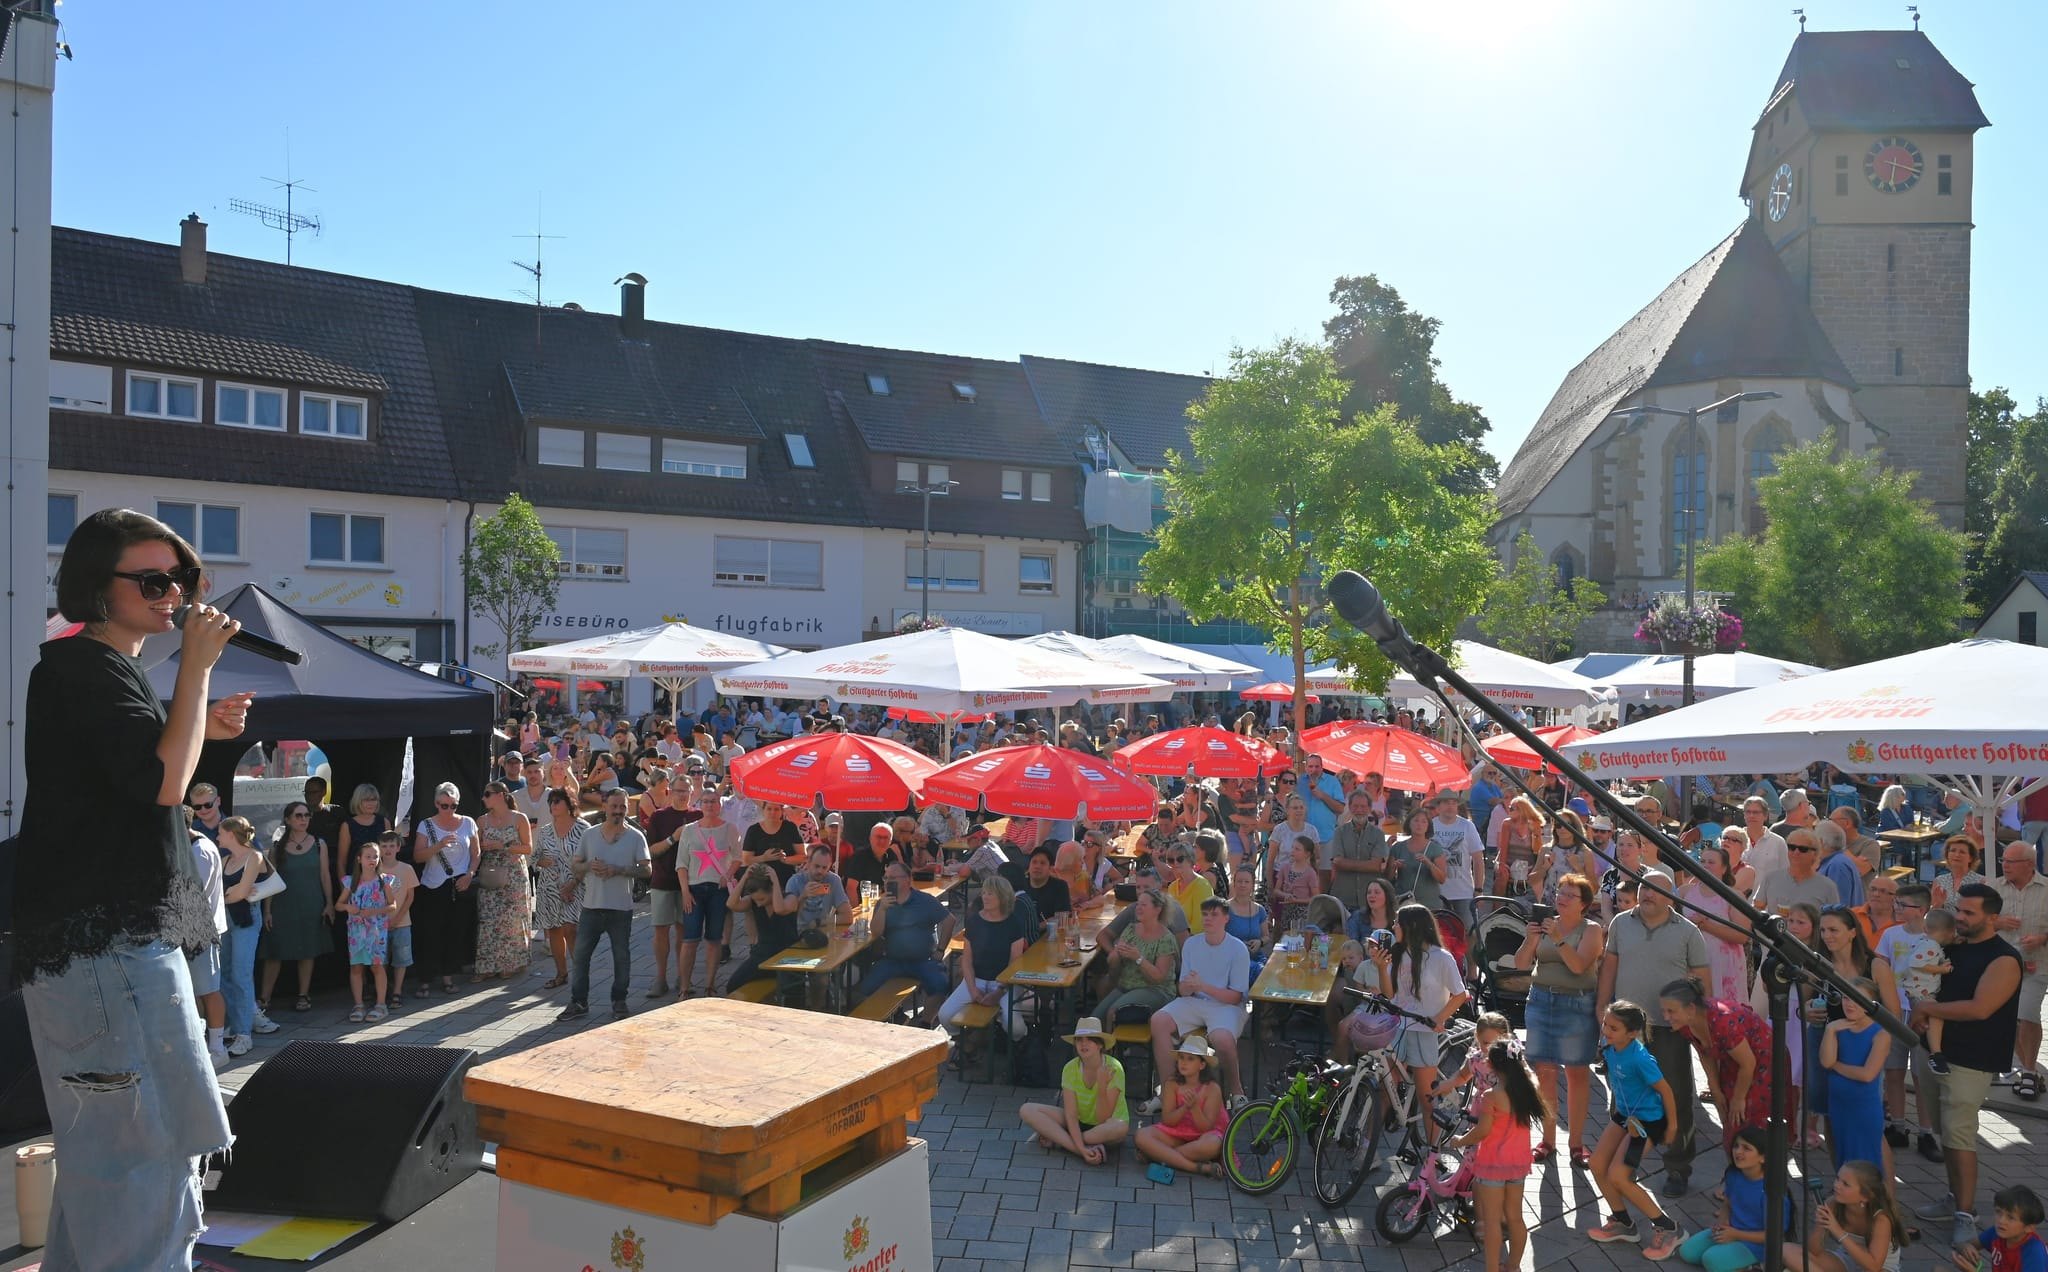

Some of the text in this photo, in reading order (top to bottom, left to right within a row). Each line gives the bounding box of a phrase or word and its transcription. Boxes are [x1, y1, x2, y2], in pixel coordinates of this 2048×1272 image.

[519, 615, 629, 629] EISEBÜRO
[715, 615, 824, 635] flugfabrik
[850, 686, 918, 700] Stuttgarter Hofbräu
[1501, 688, 1534, 699] Hofbräu
[1599, 746, 1727, 769] Stuttgarter Hofbräu
[1878, 742, 2048, 764] Stuttgarter Hofbrä
